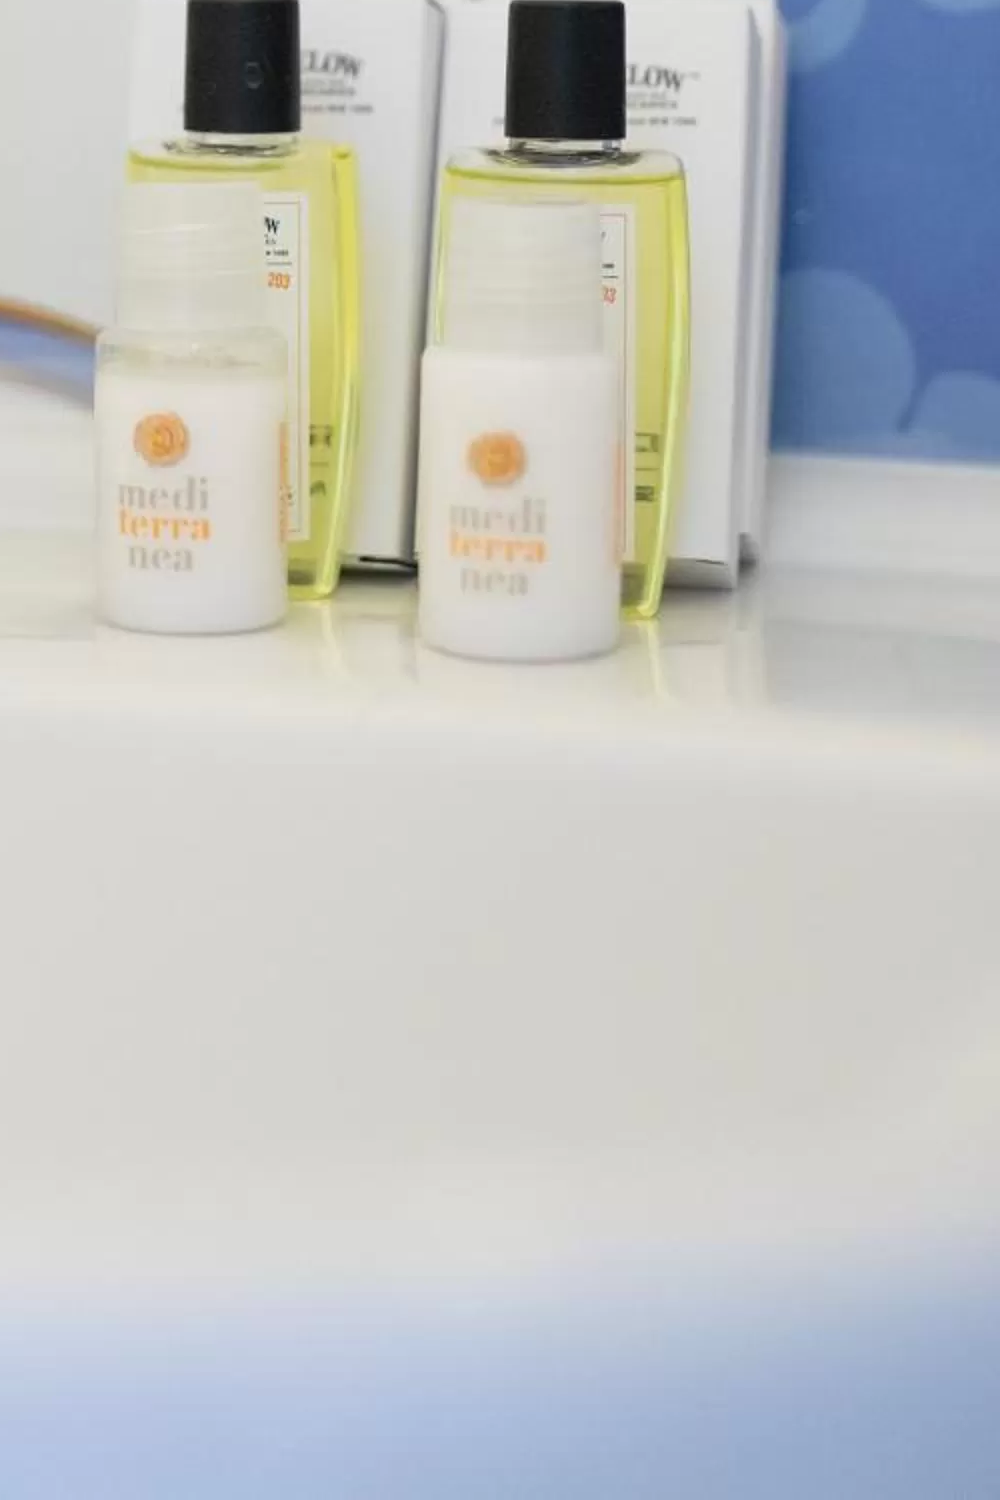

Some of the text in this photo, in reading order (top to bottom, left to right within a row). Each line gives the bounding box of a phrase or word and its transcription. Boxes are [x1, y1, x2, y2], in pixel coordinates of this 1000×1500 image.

[627, 63, 683, 94] LOW
[118, 475, 209, 511] medi
[118, 508, 211, 540] terra
[450, 497, 547, 533] medi
[128, 545, 194, 572] nea
[450, 528, 548, 563] terra
[460, 568, 529, 596] nea
